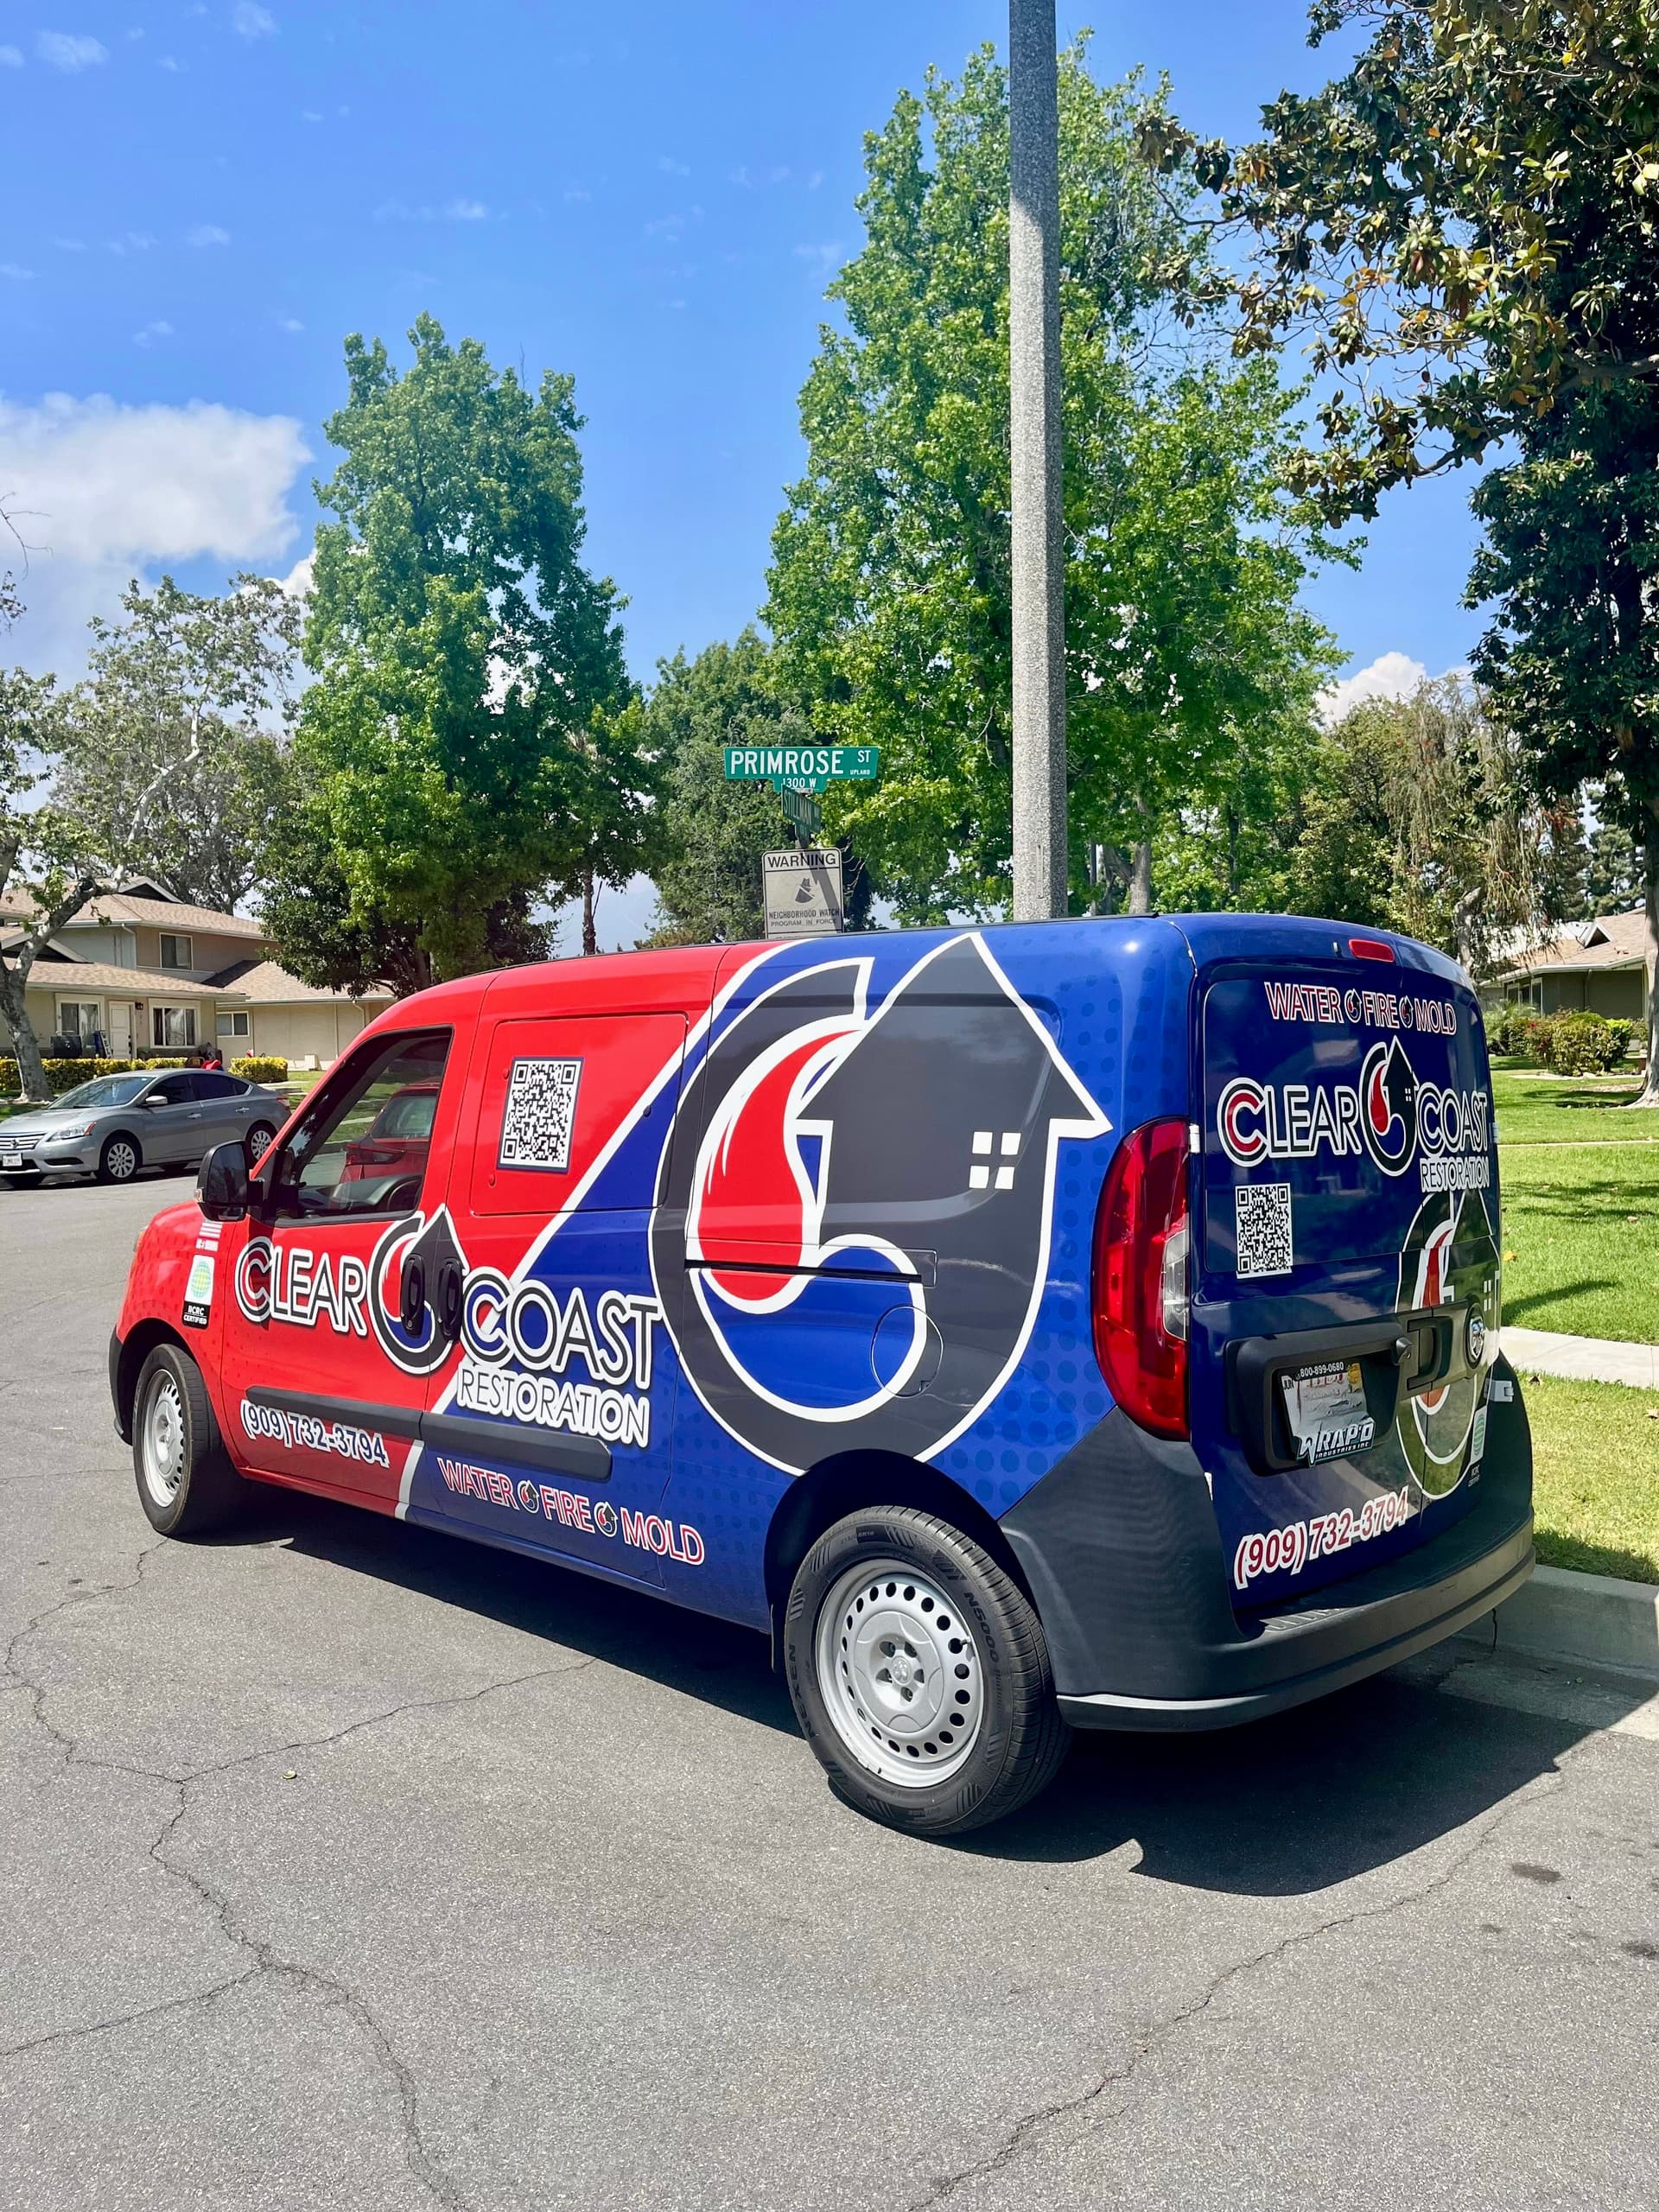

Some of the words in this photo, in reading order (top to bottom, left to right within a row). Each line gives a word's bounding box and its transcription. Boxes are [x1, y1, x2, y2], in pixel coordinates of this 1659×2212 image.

[730, 750, 844, 775] PRIMROSE
[857, 750, 871, 763] ST
[783, 778, 805, 788] 1300
[809, 778, 817, 788] W
[767, 853, 836, 868] WARNING
[769, 910, 817, 919] NEIGHBORHOOD
[1264, 982, 1344, 1023] WATER
[1362, 991, 1400, 1028] FIRE
[1414, 999, 1457, 1035] MOLD
[1217, 1077, 1363, 1167] CLEAR
[1417, 1082, 1488, 1156] COAST
[1419, 1157, 1490, 1193] RESTORATION
[235, 1236, 367, 1336] CLEAR
[461, 1267, 666, 1389] COAST
[458, 1361, 650, 1448] RESTORATION
[436, 1457, 519, 1510] WATER
[538, 1484, 595, 1534] FIRE
[620, 1507, 705, 1566] MOLD
[963, 1592, 1000, 1662] N5000
